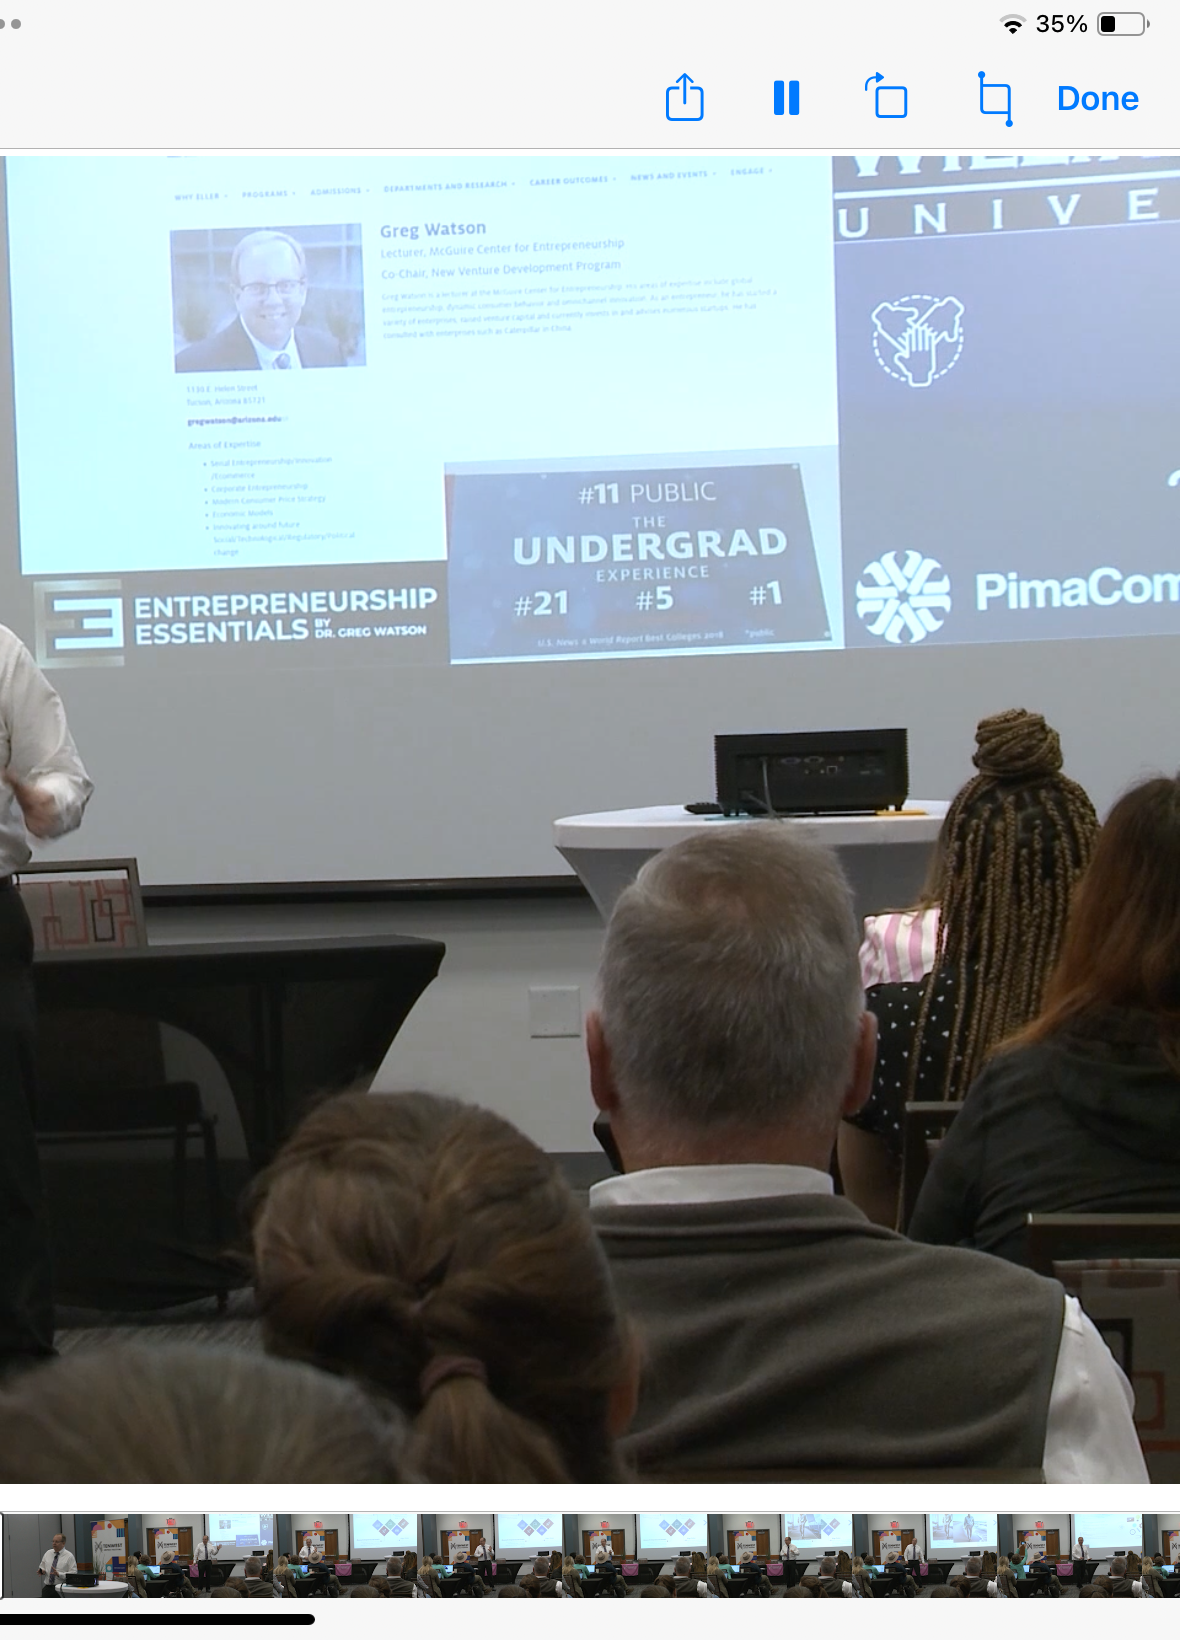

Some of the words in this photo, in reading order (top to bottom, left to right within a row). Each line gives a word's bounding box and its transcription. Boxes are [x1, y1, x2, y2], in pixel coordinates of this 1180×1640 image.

[631, 173, 655, 181] NEWS
[656, 172, 674, 180] AND
[677, 170, 708, 179] EVENTS
[731, 167, 764, 176] ENGAGE
[383, 183, 443, 193] DEPARTMENTS
[445, 182, 463, 191] AND
[465, 180, 508, 189] RESEARCH
[529, 177, 561, 186] CAREER
[563, 175, 608, 184] OUTCOMES
[242, 190, 288, 198] PROGRAMS
[310, 187, 362, 196] ADMISSIONS
[380, 223, 419, 239] Greg
[424, 222, 487, 237] Watson
[381, 247, 426, 259] Lecturer,
[429, 245, 474, 257] McGuire
[476, 243, 512, 255] Center
[514, 242, 530, 253] for
[532, 238, 625, 252] Entrepreneurship
[381, 269, 429, 280] Co-Chair,
[431, 267, 455, 277] New
[458, 265, 500, 277] Venture
[503, 262, 574, 275] Development
[576, 259, 621, 272] Program
[188, 442, 212, 450] Areas
[213, 440, 222, 449] of
[223, 440, 262, 450] Expertise
[578, 482, 620, 505] #11
[630, 481, 717, 503] PUBLIC
[632, 515, 667, 529] THE
[513, 527, 788, 566] UNDERGRAD
[596, 565, 710, 583] EXPERIENCE
[635, 586, 675, 611] #5
[749, 580, 783, 606] #1
[134, 586, 439, 619] ENTREPRENEURSHIP
[514, 590, 569, 617] #21
[314, 617, 331, 628] BY
[135, 618, 310, 646] ESSENTIALS
[314, 627, 336, 639] DR.
[337, 626, 372, 638] GREG
[373, 624, 428, 637] WATSON
